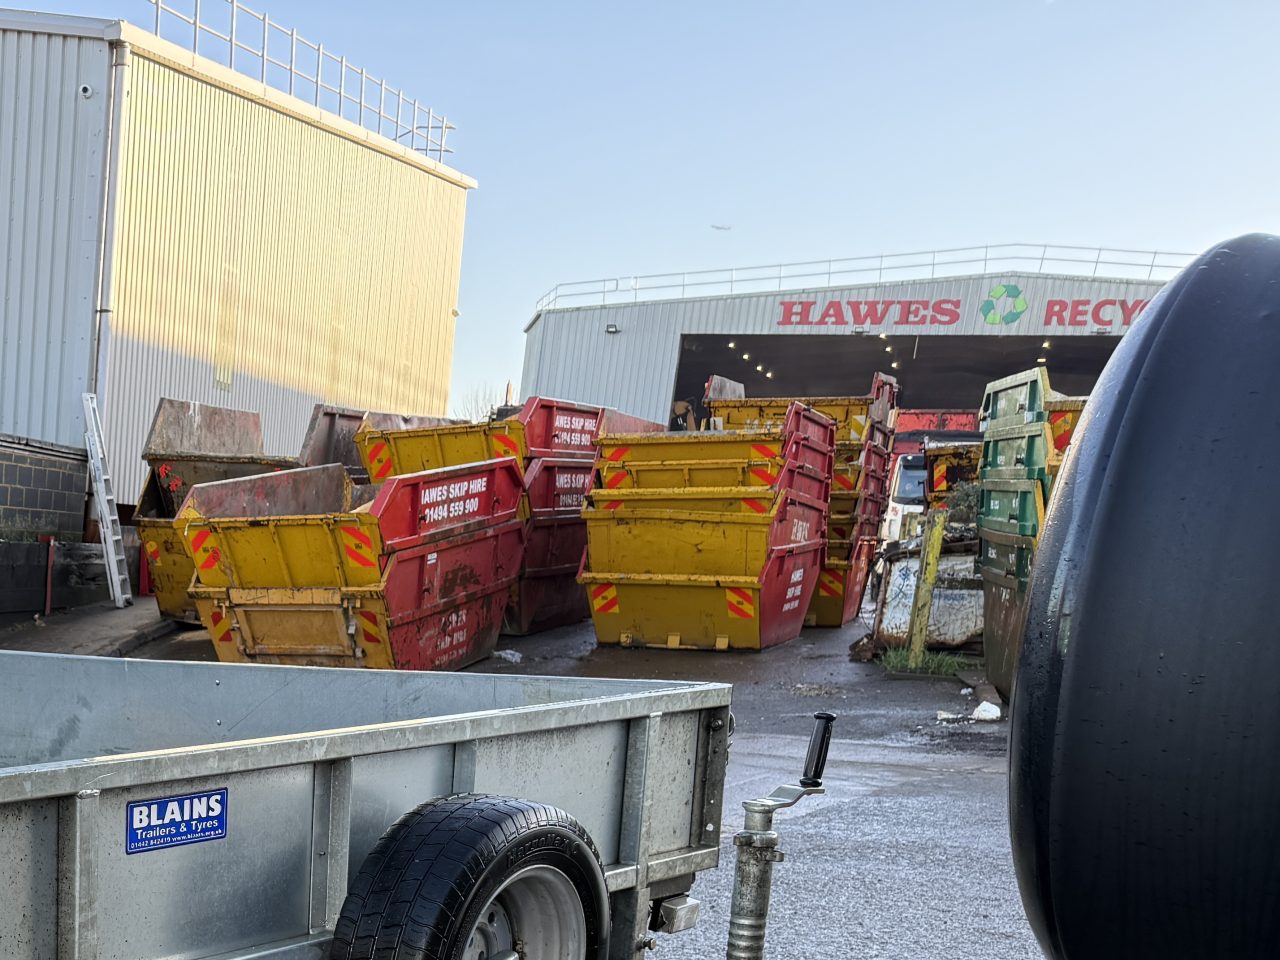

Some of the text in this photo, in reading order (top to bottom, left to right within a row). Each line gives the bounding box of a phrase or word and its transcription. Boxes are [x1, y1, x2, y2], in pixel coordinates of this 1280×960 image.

[777, 299, 961, 326] HAWES
[555, 415, 571, 429] AWES
[449, 481, 468, 499] SKIP
[469, 477, 487, 494] HIRE
[449, 500, 464, 517] 559
[465, 497, 479, 513] 900
[133, 795, 222, 829] BLAINS
[136, 820, 218, 839] Trailers & Tyres
